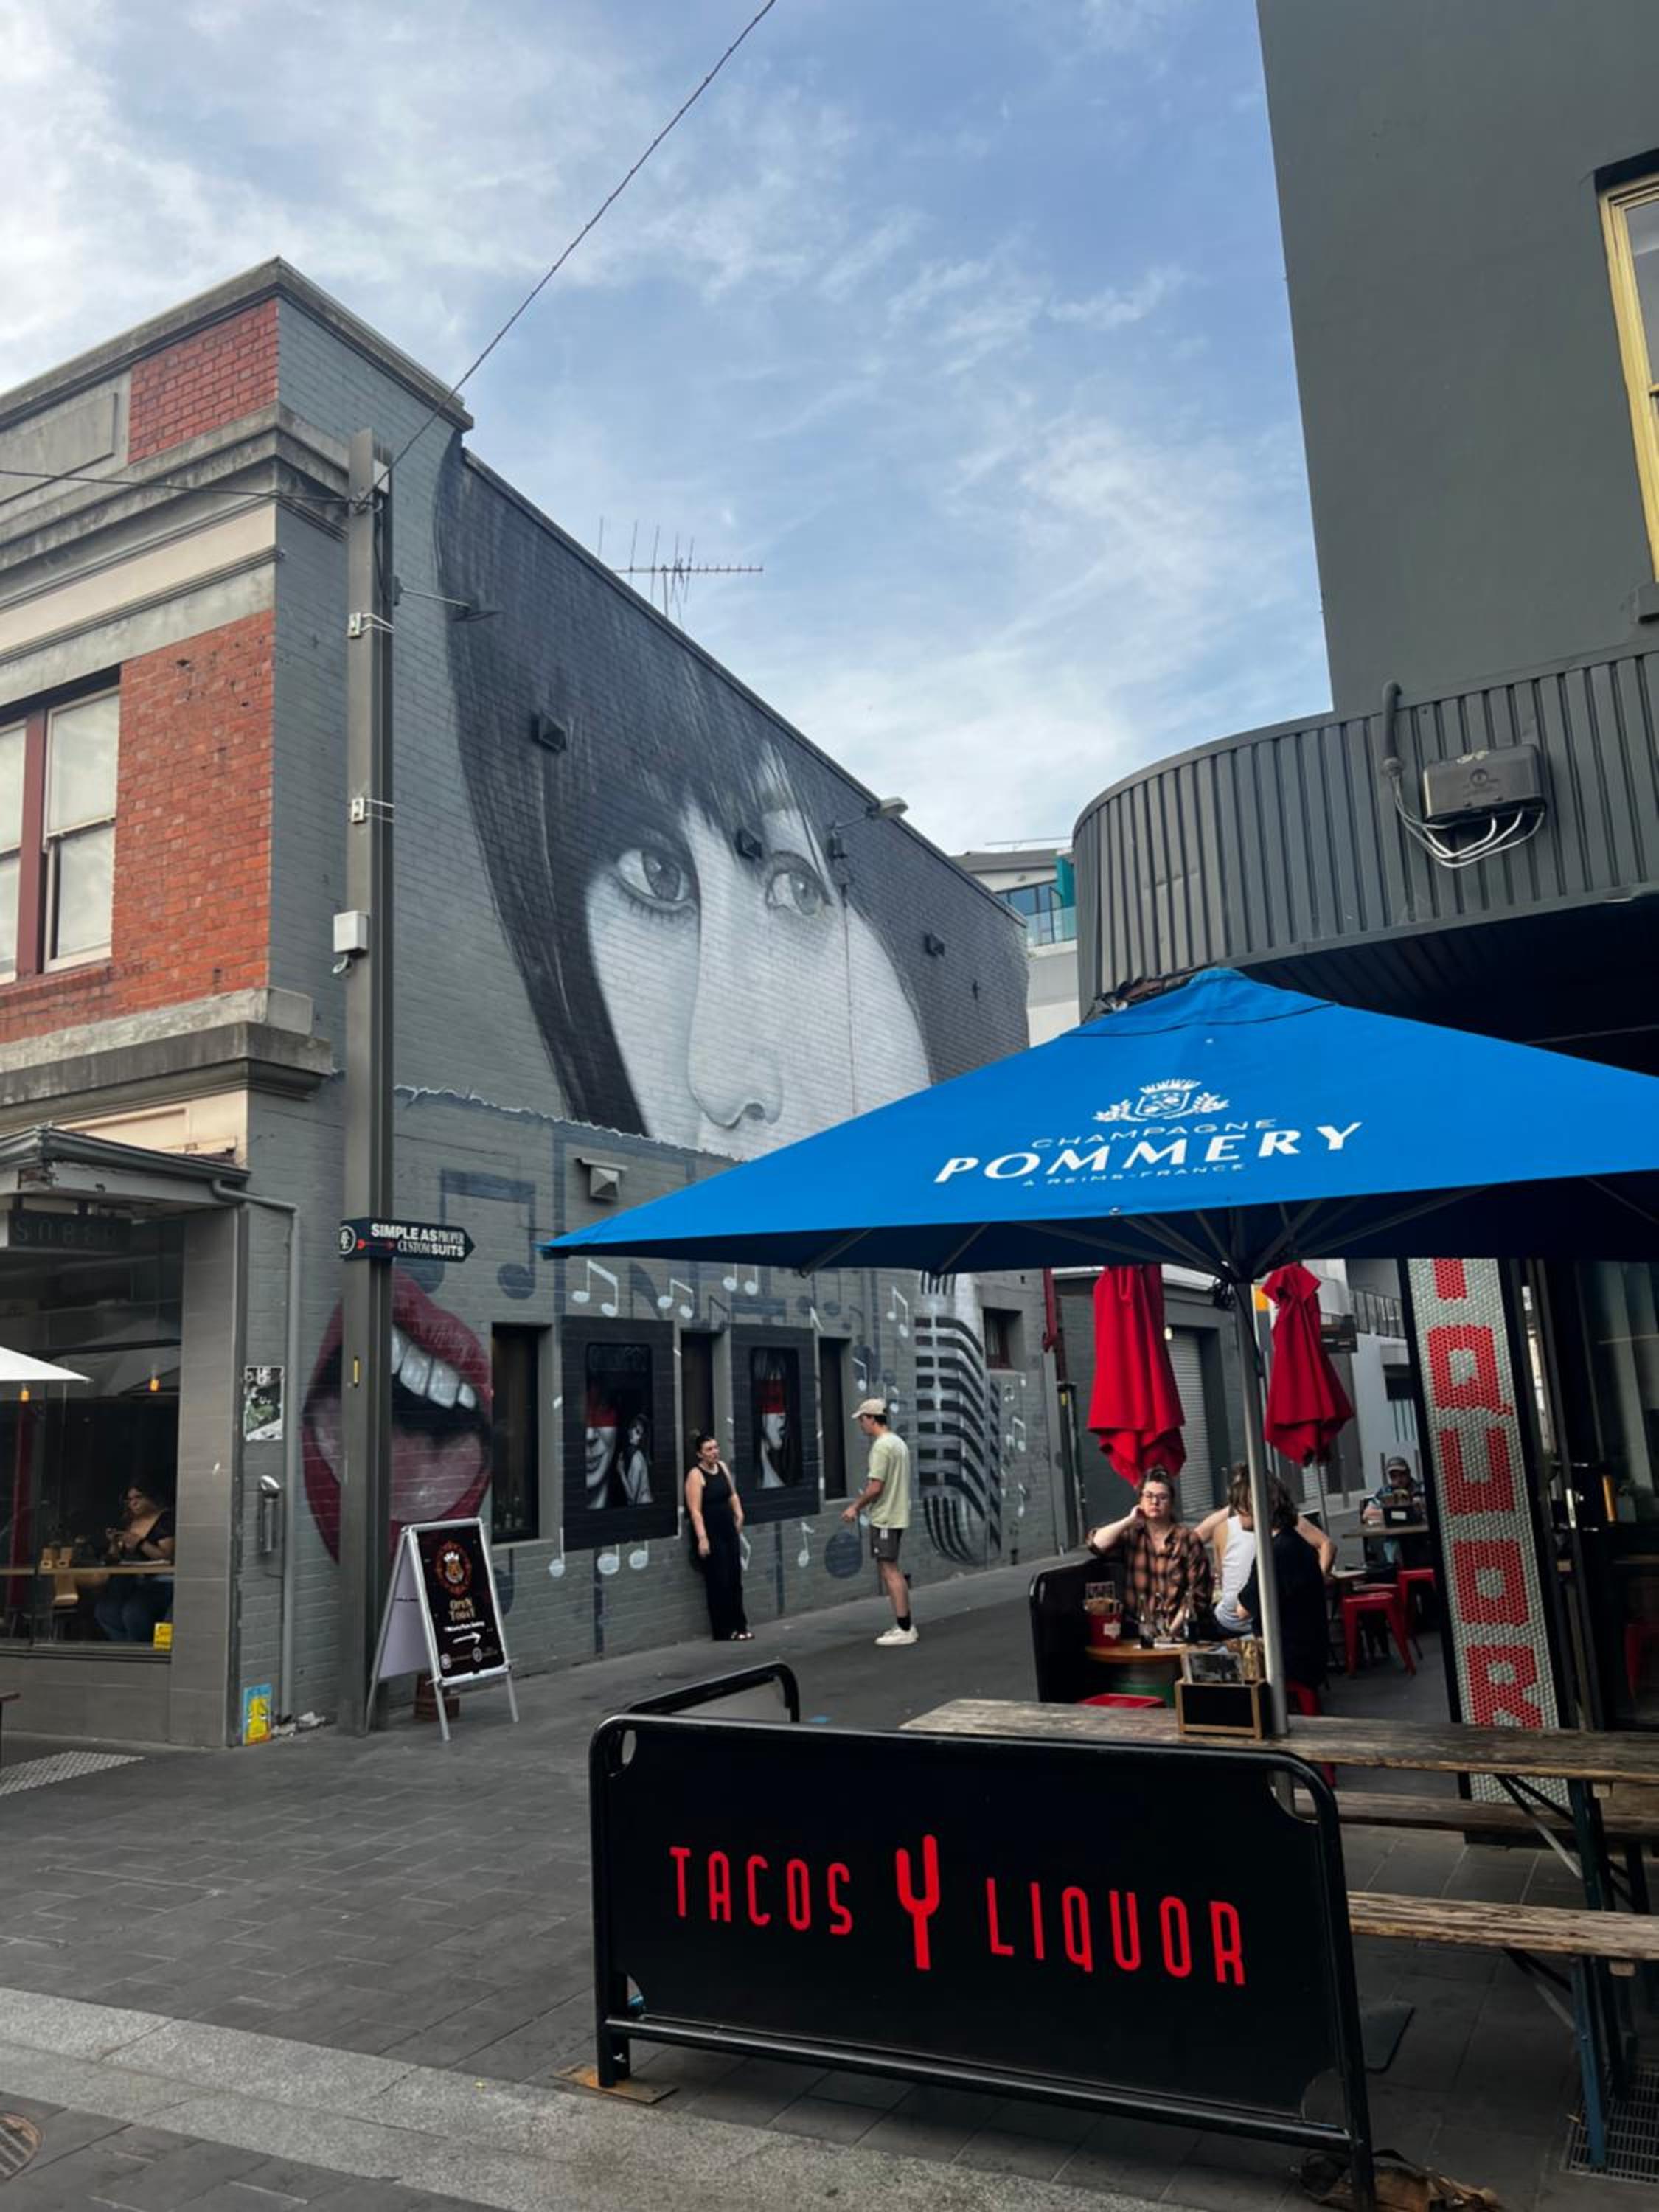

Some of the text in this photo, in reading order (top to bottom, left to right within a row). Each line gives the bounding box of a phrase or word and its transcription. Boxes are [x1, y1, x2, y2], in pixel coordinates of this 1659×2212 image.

[1032, 1119, 1277, 1149] CHAMPAGNE
[933, 1121, 1362, 1184] POMMERY
[371, 1223, 417, 1240] SIMPLE
[420, 1230, 437, 1242] AS
[397, 1239, 465, 1257] CUSTOM SUITS
[669, 1846, 853, 1936] TACOS
[986, 1877, 1245, 1986] LIQUOR
